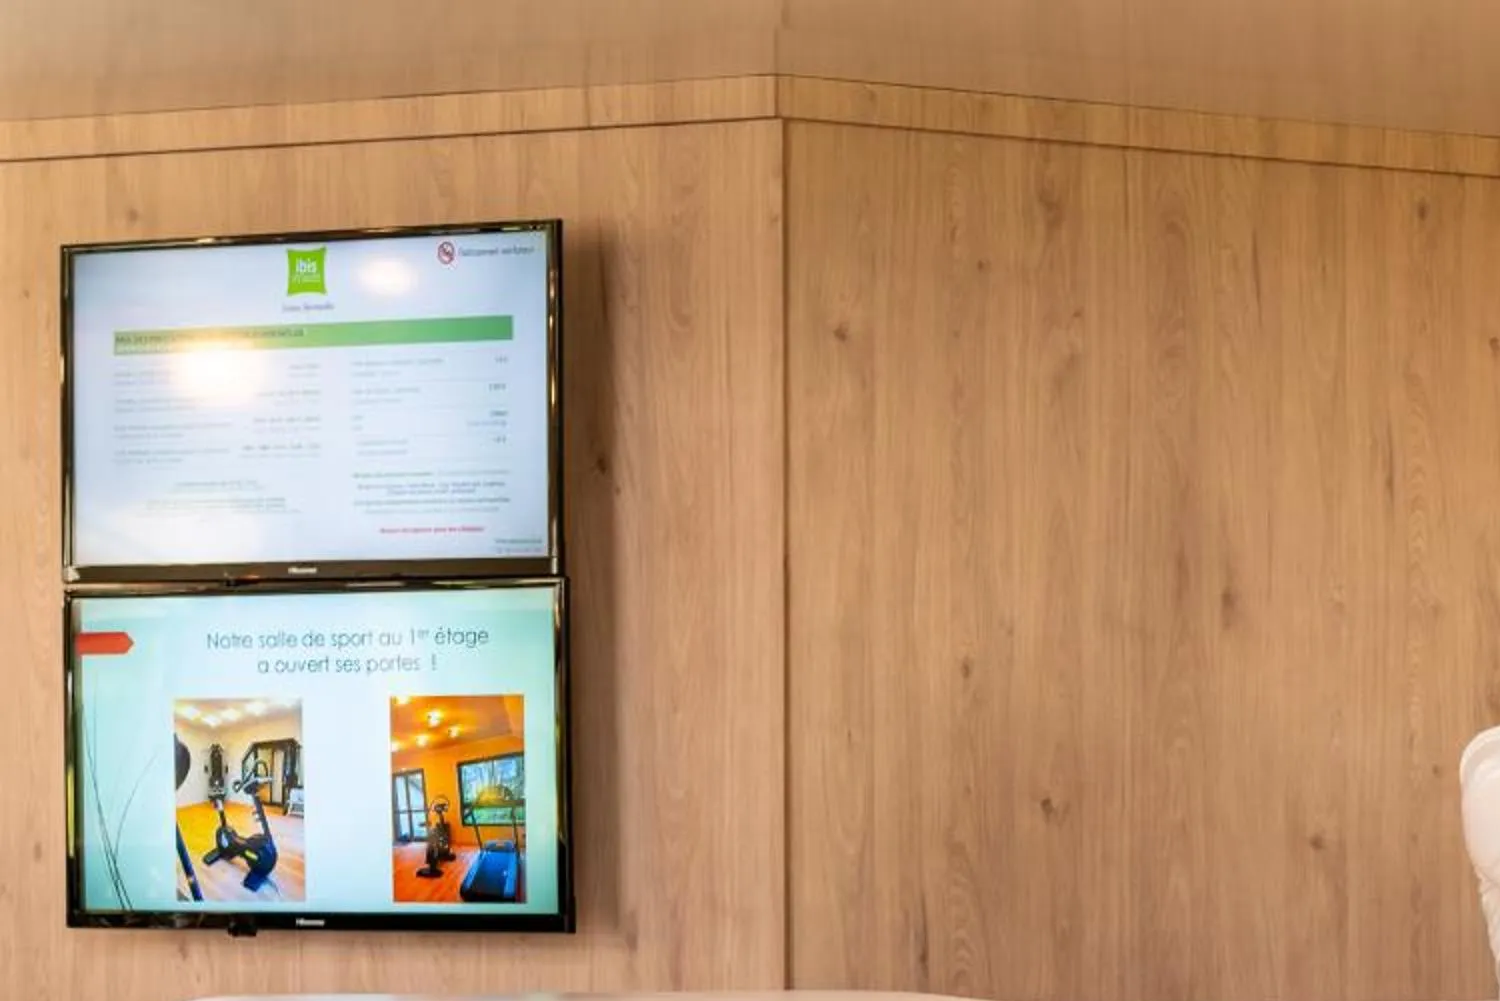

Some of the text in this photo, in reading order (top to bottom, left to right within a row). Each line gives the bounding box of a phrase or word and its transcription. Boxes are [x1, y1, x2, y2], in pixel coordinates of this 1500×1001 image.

[295, 257, 317, 273] ibis
[206, 632, 253, 649] Notre
[258, 630, 298, 648] salle
[301, 630, 325, 647] de
[331, 629, 373, 652] sport
[379, 632, 402, 647] au
[434, 626, 489, 649] étage
[257, 659, 269, 674] a
[275, 656, 329, 674] ouvert
[335, 658, 361, 673] ses
[366, 655, 421, 676] portes
